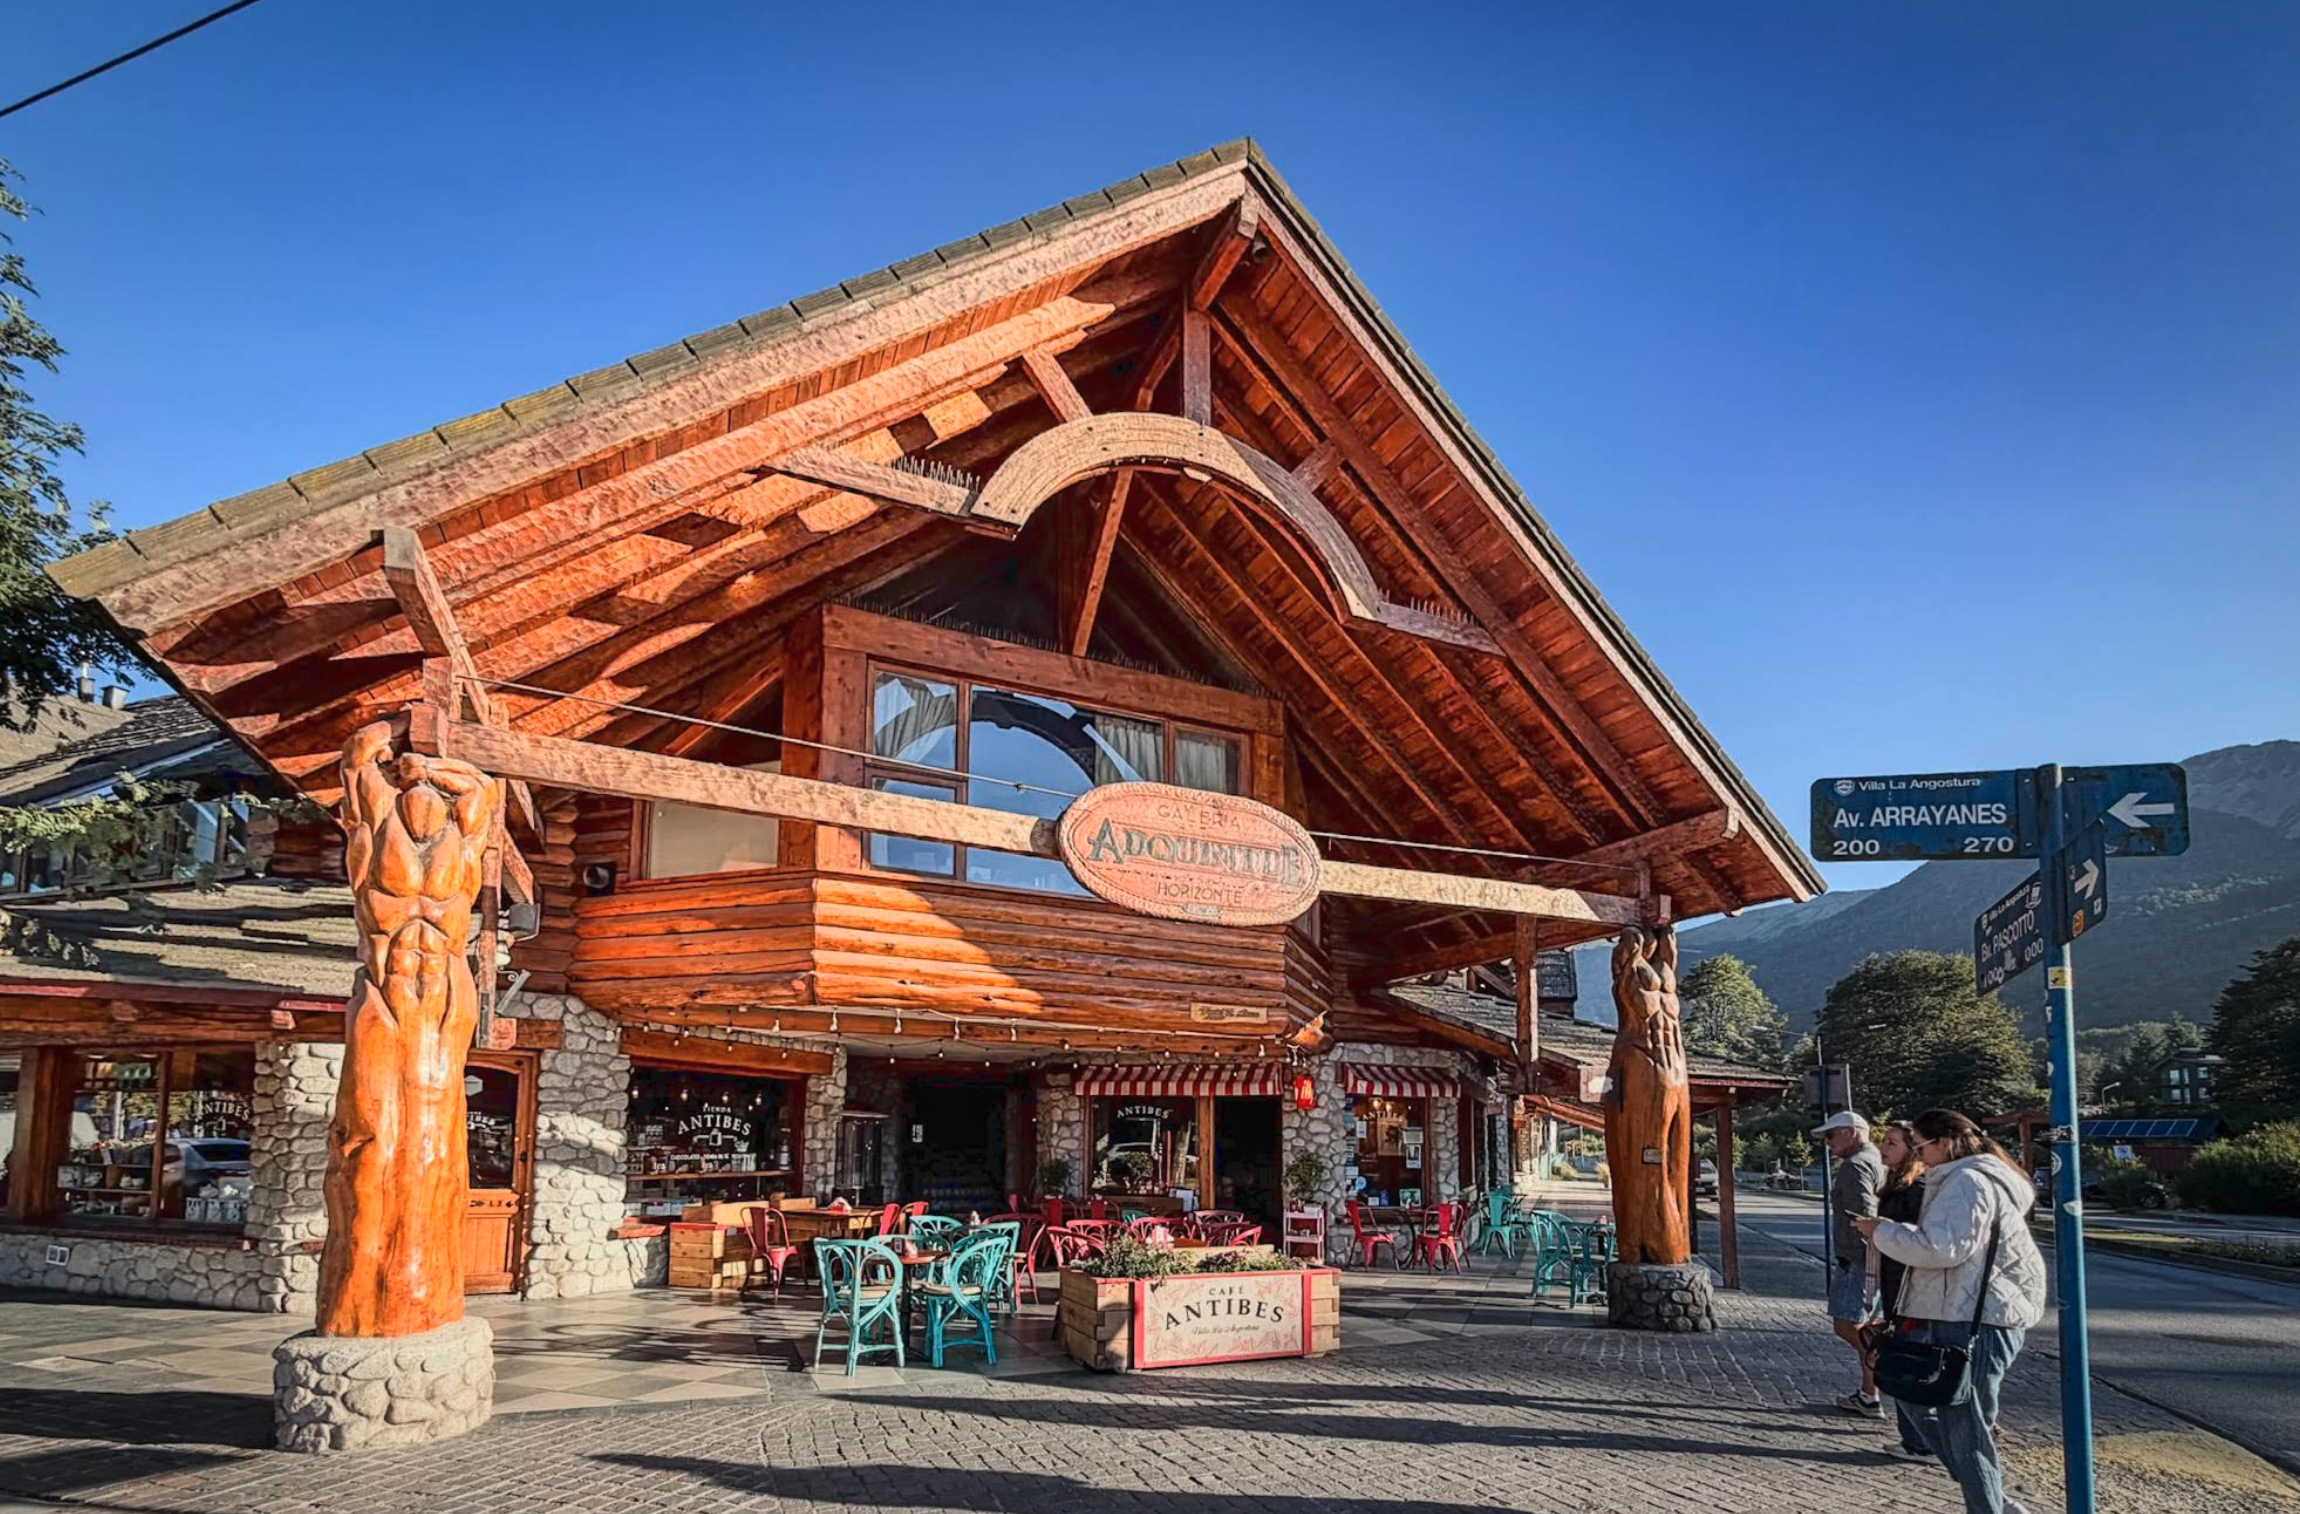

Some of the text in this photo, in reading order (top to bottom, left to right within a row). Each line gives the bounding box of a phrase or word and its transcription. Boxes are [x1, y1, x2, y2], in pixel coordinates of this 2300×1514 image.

[1859, 778, 1981, 792] Villa La Angostura
[1833, 803, 2008, 828] Av. ARRAYANES
[1833, 836, 2014, 856] 200 270
[1157, 881, 1244, 904] HORIZONTE
[1993, 909, 2034, 955] PASCOTTO
[2024, 937, 2044, 962] 000
[1117, 1105, 1169, 1120] ANTIBES
[678, 1114, 752, 1136] ANTIBES
[1164, 1298, 1284, 1331] ANTIBES
